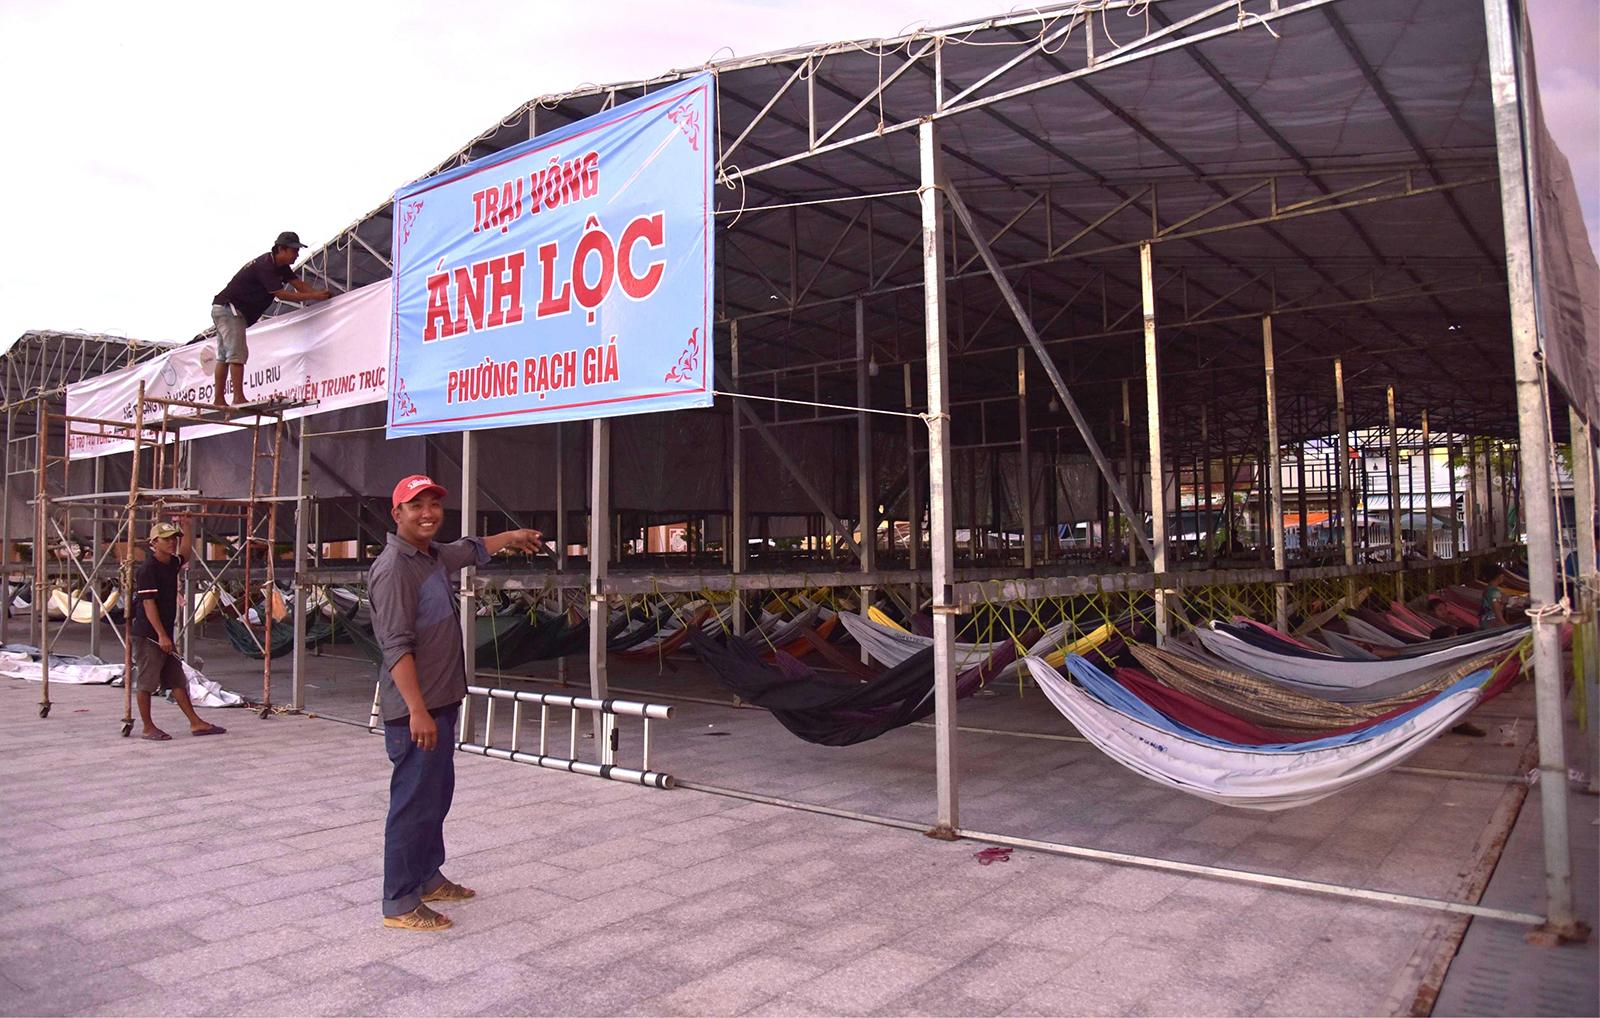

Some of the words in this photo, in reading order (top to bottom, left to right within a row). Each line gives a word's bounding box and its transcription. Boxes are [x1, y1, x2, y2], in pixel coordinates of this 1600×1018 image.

[472, 177, 524, 234] TRẠI
[530, 152, 600, 214] VÕNG
[423, 252, 526, 342] ÁNH
[537, 213, 665, 323] LỘC
[199, 384, 216, 402] BỌ
[249, 368, 264, 388] LIU
[266, 365, 281, 384] RIU
[321, 374, 356, 398] TRUNG
[359, 367, 386, 392] TRỰC
[447, 357, 519, 404] PHƯỜNG
[523, 350, 577, 399] RẠCH
[583, 336, 620, 385] GIÁ
